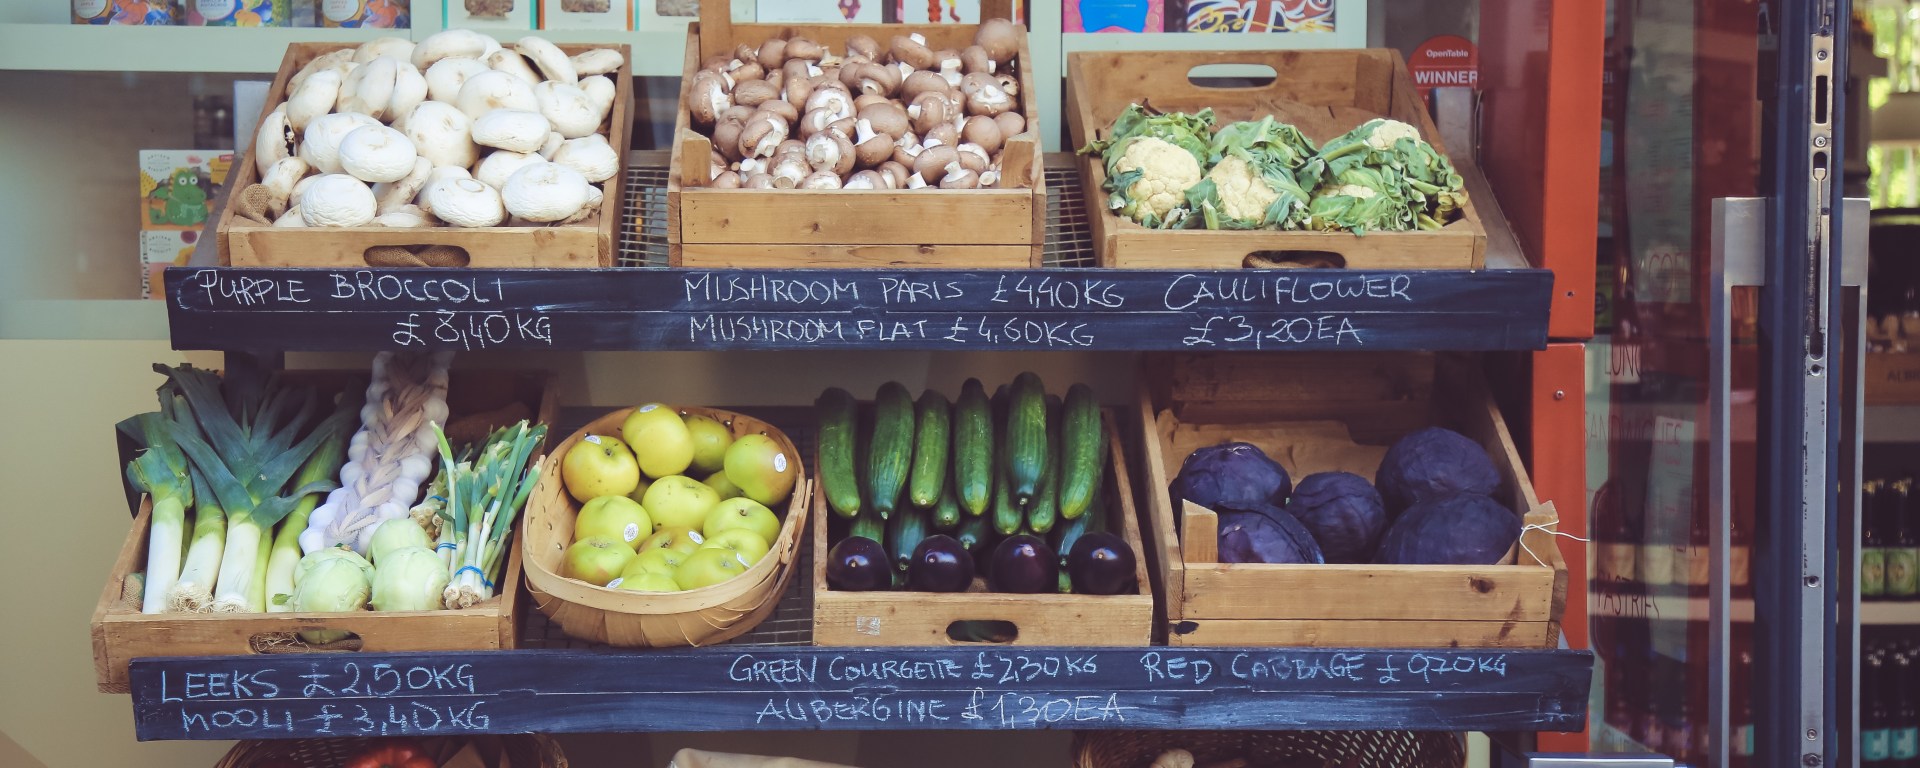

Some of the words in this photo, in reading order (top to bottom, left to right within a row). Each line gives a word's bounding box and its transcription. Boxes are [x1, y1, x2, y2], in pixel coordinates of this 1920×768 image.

[1426, 49, 1468, 58] OpenTable
[1415, 70, 1478, 84] WINNER
[195, 270, 311, 305] PURPLE
[330, 271, 503, 303] BROCCOLI
[684, 277, 858, 303] MUSHROOM
[878, 277, 963, 302] PARIS
[1165, 274, 1413, 310] CAULIFLOWER
[689, 316, 843, 342] MUSHROOM
[858, 319, 927, 341] FLAT
[729, 653, 817, 684] GREEN
[1140, 651, 1213, 684] RED
[1231, 653, 1366, 683] CABBAGE
[161, 668, 280, 704] LEEKS
[181, 707, 293, 733] MOOLI
[756, 697, 950, 724] AUBERGINE
